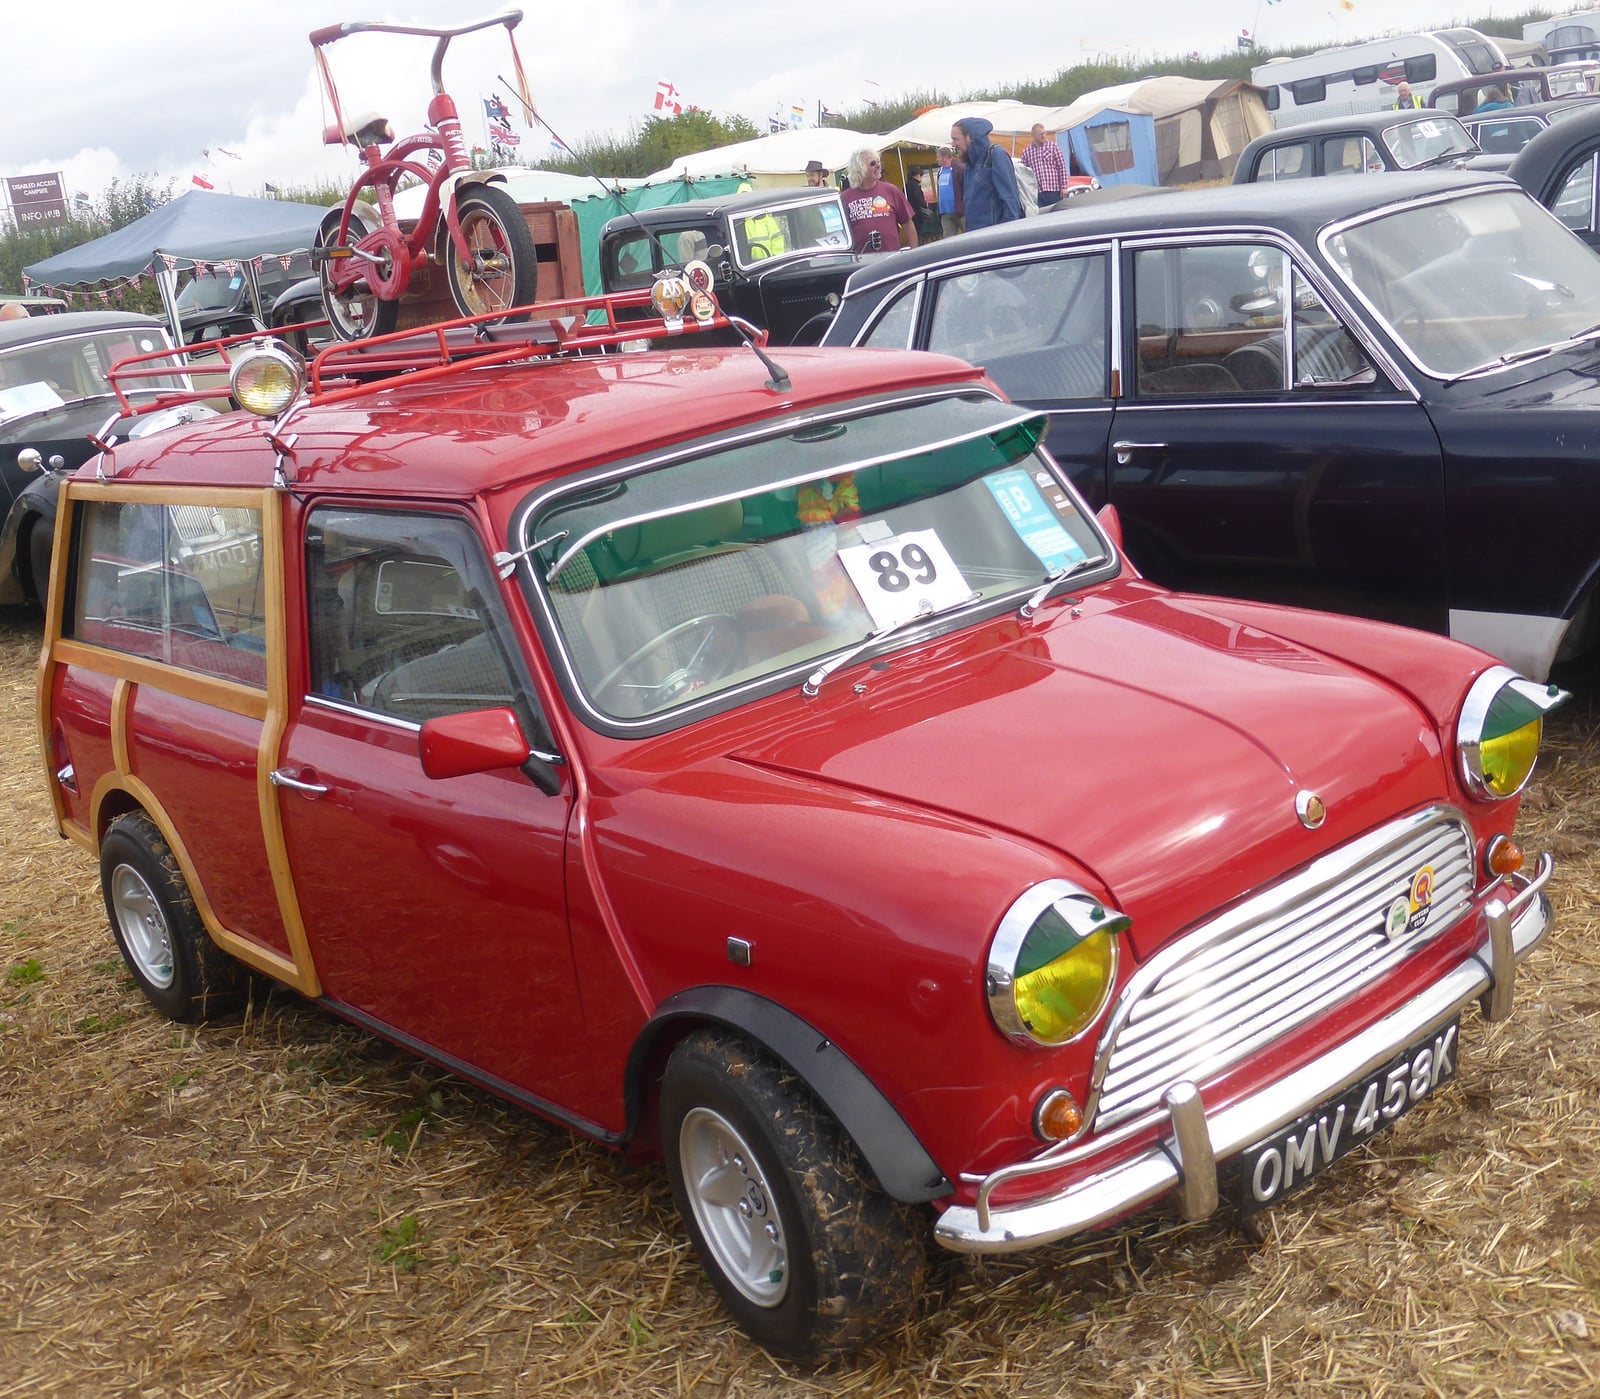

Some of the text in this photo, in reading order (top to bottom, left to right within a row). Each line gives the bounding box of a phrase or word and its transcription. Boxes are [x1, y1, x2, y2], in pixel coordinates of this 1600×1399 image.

[36, 180, 57, 188] ACCESS
[21, 209, 61, 221] INFO HUB
[824, 235, 841, 246] 13
[662, 279, 681, 297] AA
[869, 543, 937, 593] 89
[1252, 1024, 1457, 1203] OMV 458K
